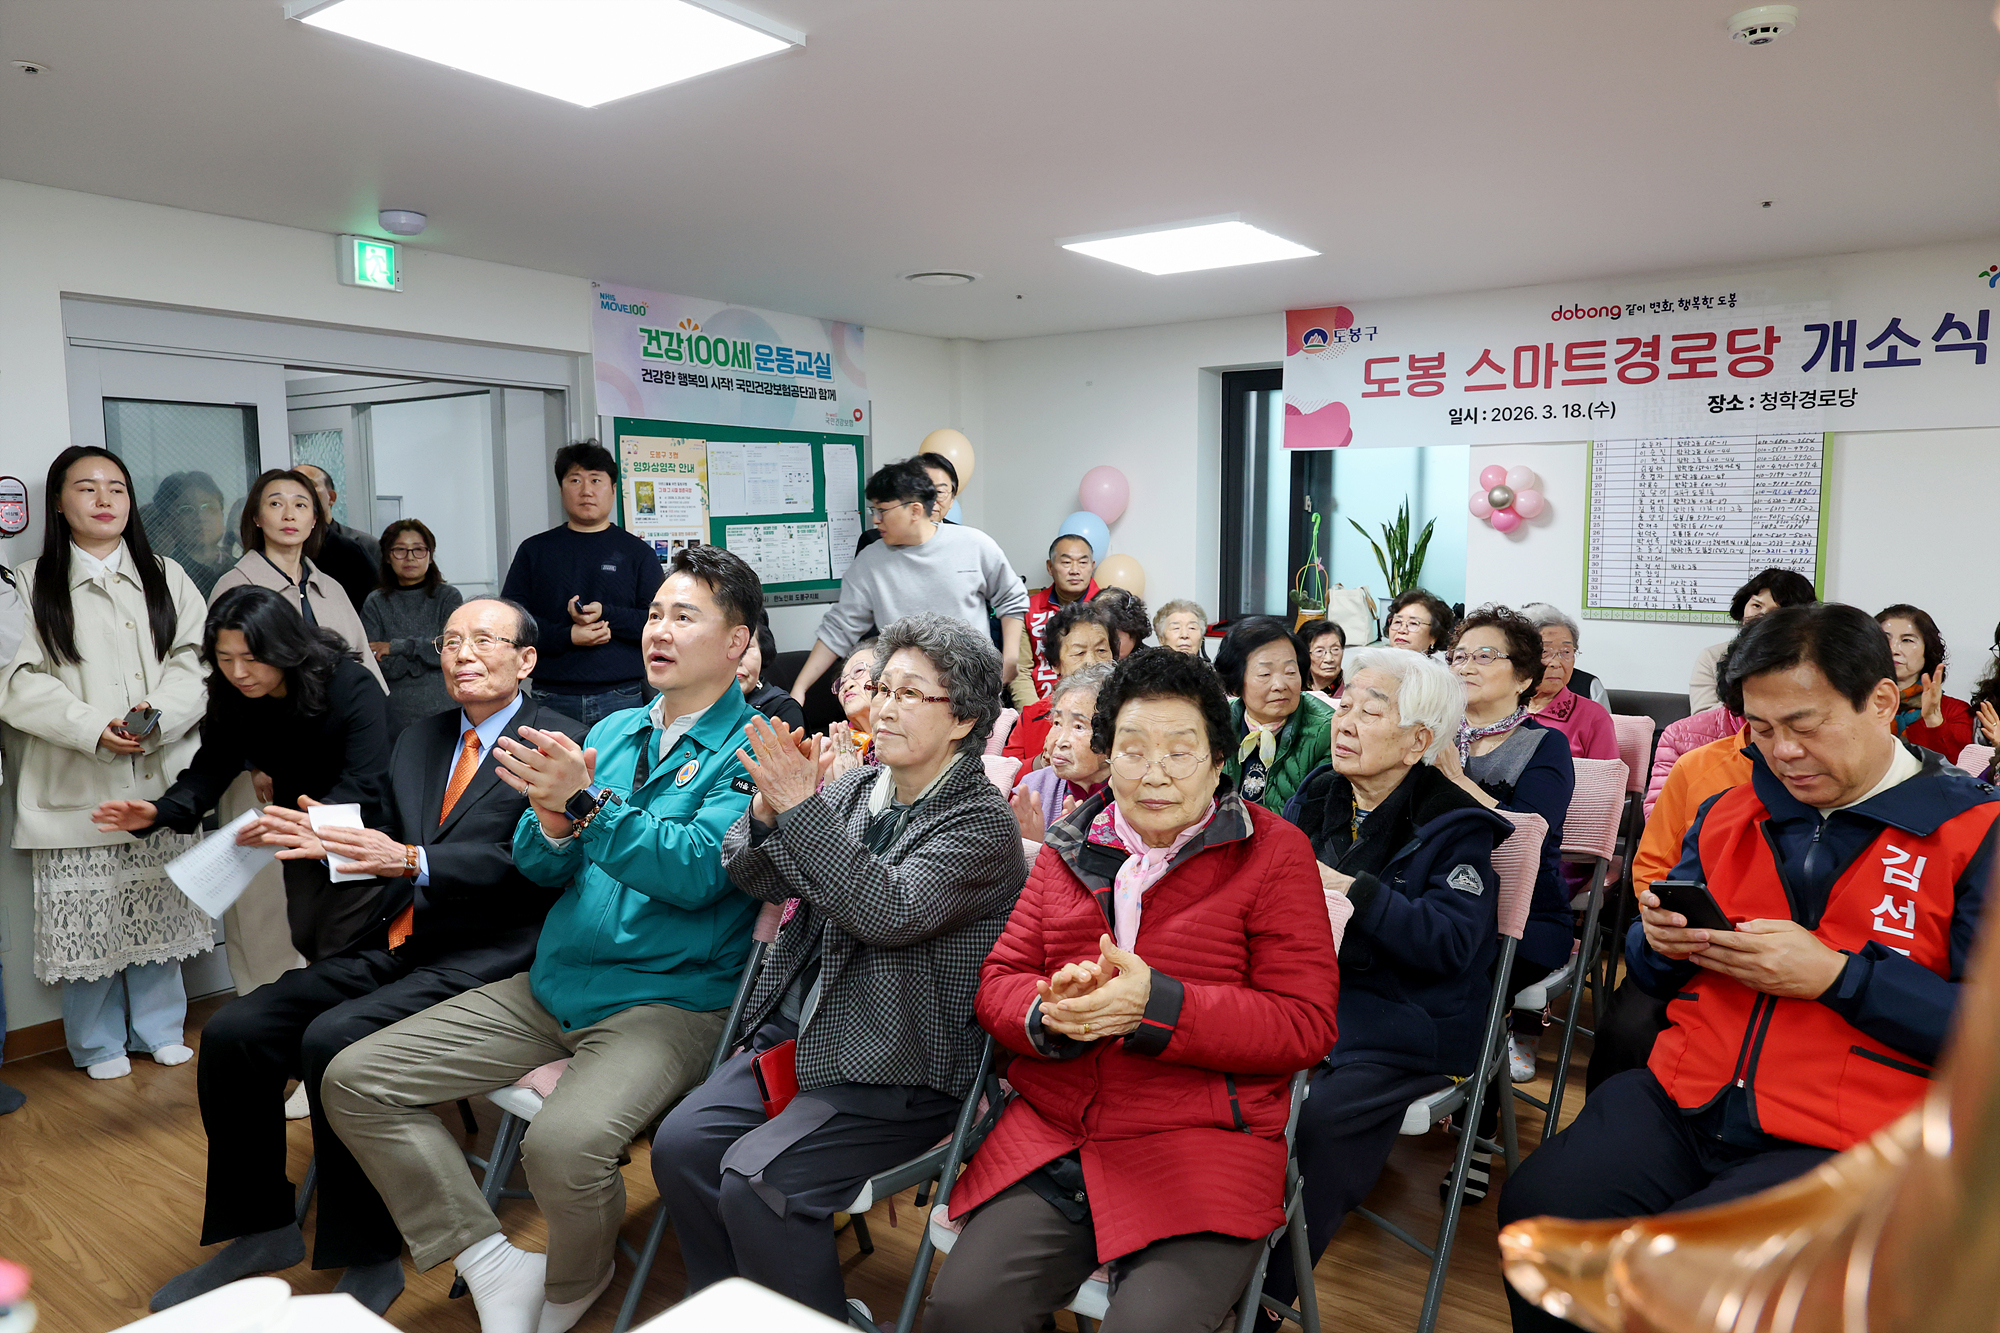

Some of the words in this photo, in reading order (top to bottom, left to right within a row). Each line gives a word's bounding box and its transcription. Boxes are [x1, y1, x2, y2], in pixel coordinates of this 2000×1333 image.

[600, 292, 616, 302] NHIS
[601, 300, 646, 316] MOVE100
[1551, 304, 1621, 320] dobong
[1625, 302, 1646, 317] 같이
[1649, 298, 1675, 314] 변화,
[1678, 295, 1714, 311] 행복한
[1717, 293, 1738, 308] 도봉
[1333, 326, 1378, 344] 도봉구
[638, 327, 752, 370] 건강100세
[755, 344, 833, 380] 운동교실
[1361, 352, 1447, 398] 도봉
[1464, 325, 1782, 392] 스마트경로당
[1801, 309, 1991, 372] 개소식
[641, 368, 676, 386] 건강한
[678, 371, 709, 389] 행복의
[711, 376, 734, 392] 시작!
[736, 379, 818, 400] 국민건강보험공단과
[818, 387, 837, 402] 함께
[1448, 407, 1478, 425] 일시
[1491, 406, 1538, 422] 2026.
[1542, 405, 1557, 420] 3.
[1562, 400, 1616, 420] 18.(수)
[1707, 394, 1745, 413] 장소
[1759, 388, 1859, 411] 청학경로당
[650, 451, 666, 459] 도봉구
[633, 462, 676, 473] 영화상영작
[679, 463, 695, 474] 안내
[736, 780, 750, 791] 서울
[1871, 844, 1928, 957] 김선
